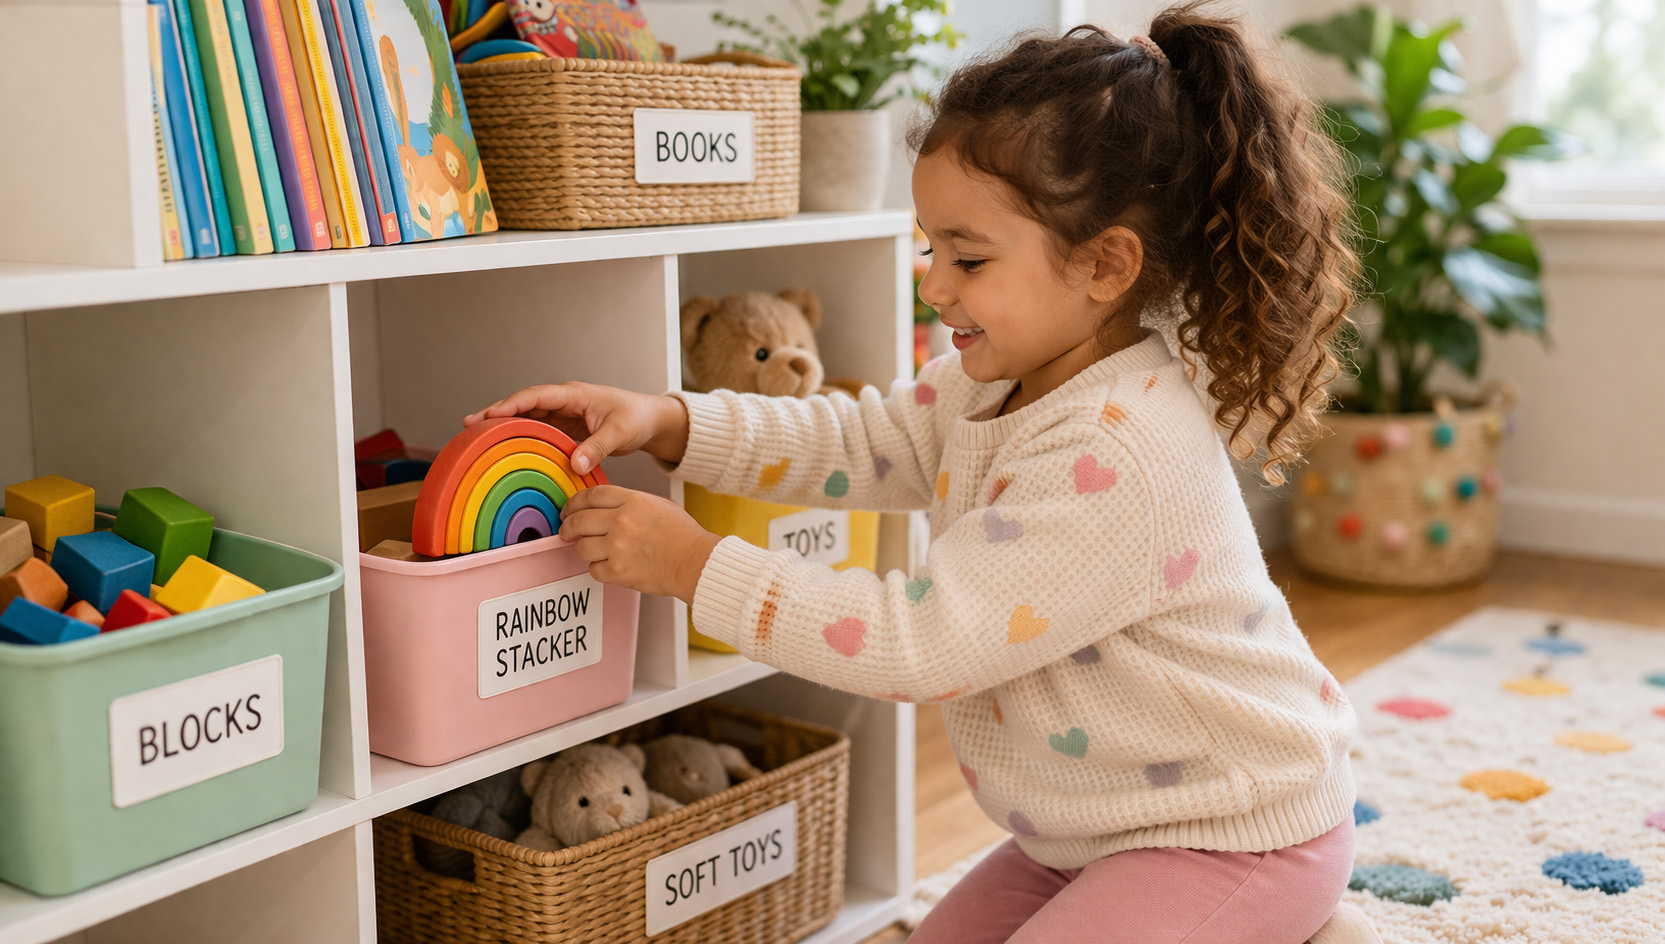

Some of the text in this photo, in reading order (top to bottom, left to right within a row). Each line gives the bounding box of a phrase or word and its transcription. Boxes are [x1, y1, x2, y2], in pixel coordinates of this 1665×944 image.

[656, 131, 737, 162] BOOKS
[783, 521, 836, 557] TOYS
[496, 587, 590, 641] RAINBOW
[496, 625, 587, 677] STACKER
[139, 694, 262, 765] BLOCKS
[665, 829, 783, 906] SOFT TOYS
